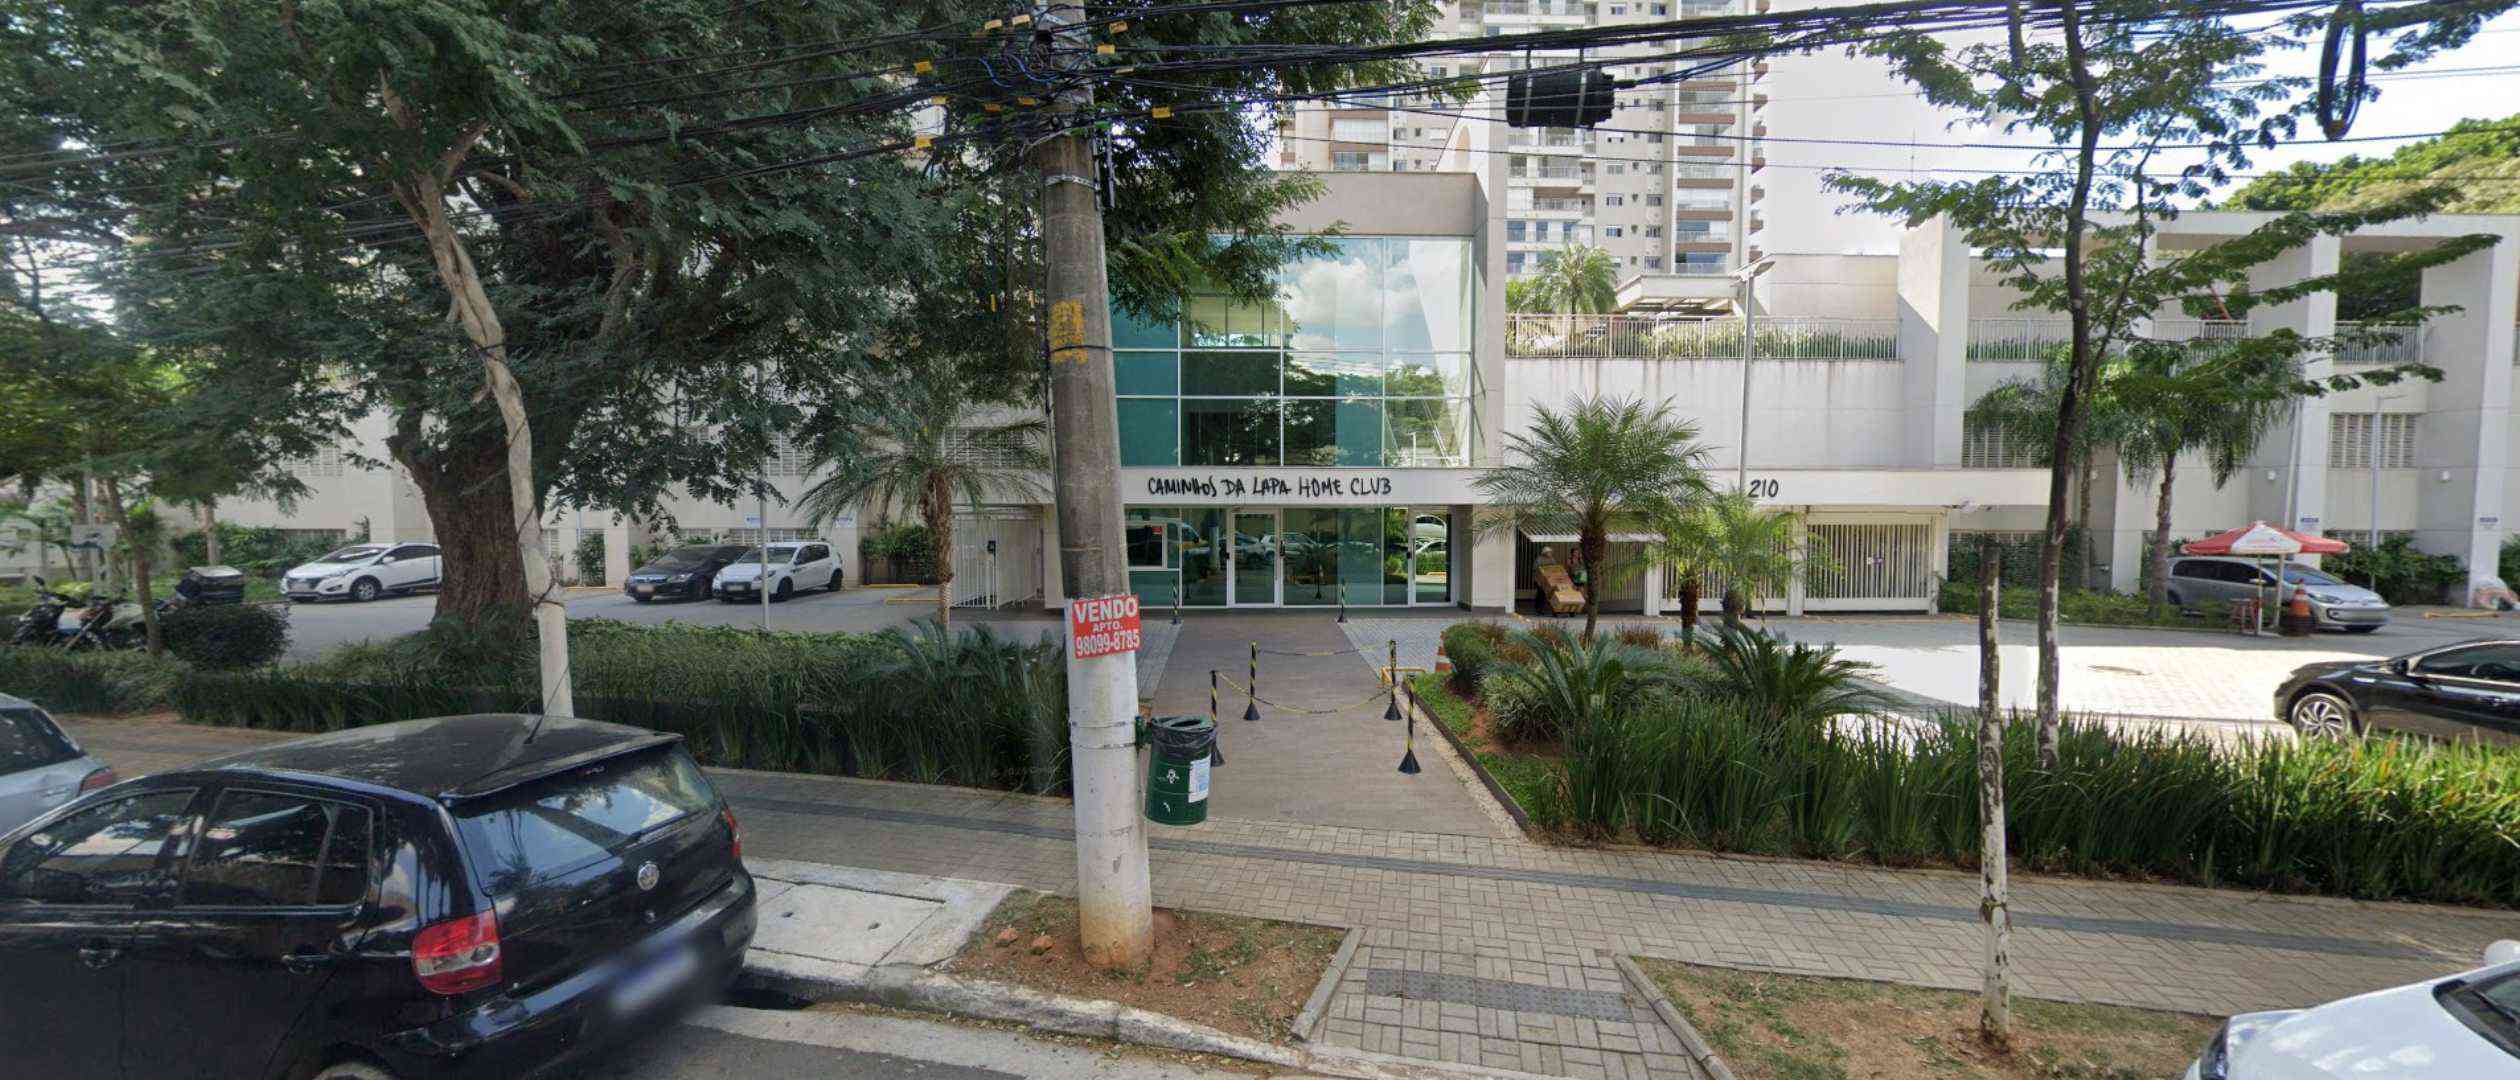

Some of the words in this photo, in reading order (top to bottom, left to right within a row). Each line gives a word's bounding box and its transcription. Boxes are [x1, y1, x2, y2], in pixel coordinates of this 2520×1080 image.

[1221, 477, 1246, 495] DA
[1252, 476, 1292, 495] LAPA
[1299, 476, 1344, 498] HOME
[1350, 477, 1392, 495] CLUB
[1748, 479, 1779, 498] 210
[1074, 597, 1137, 623] VENDO
